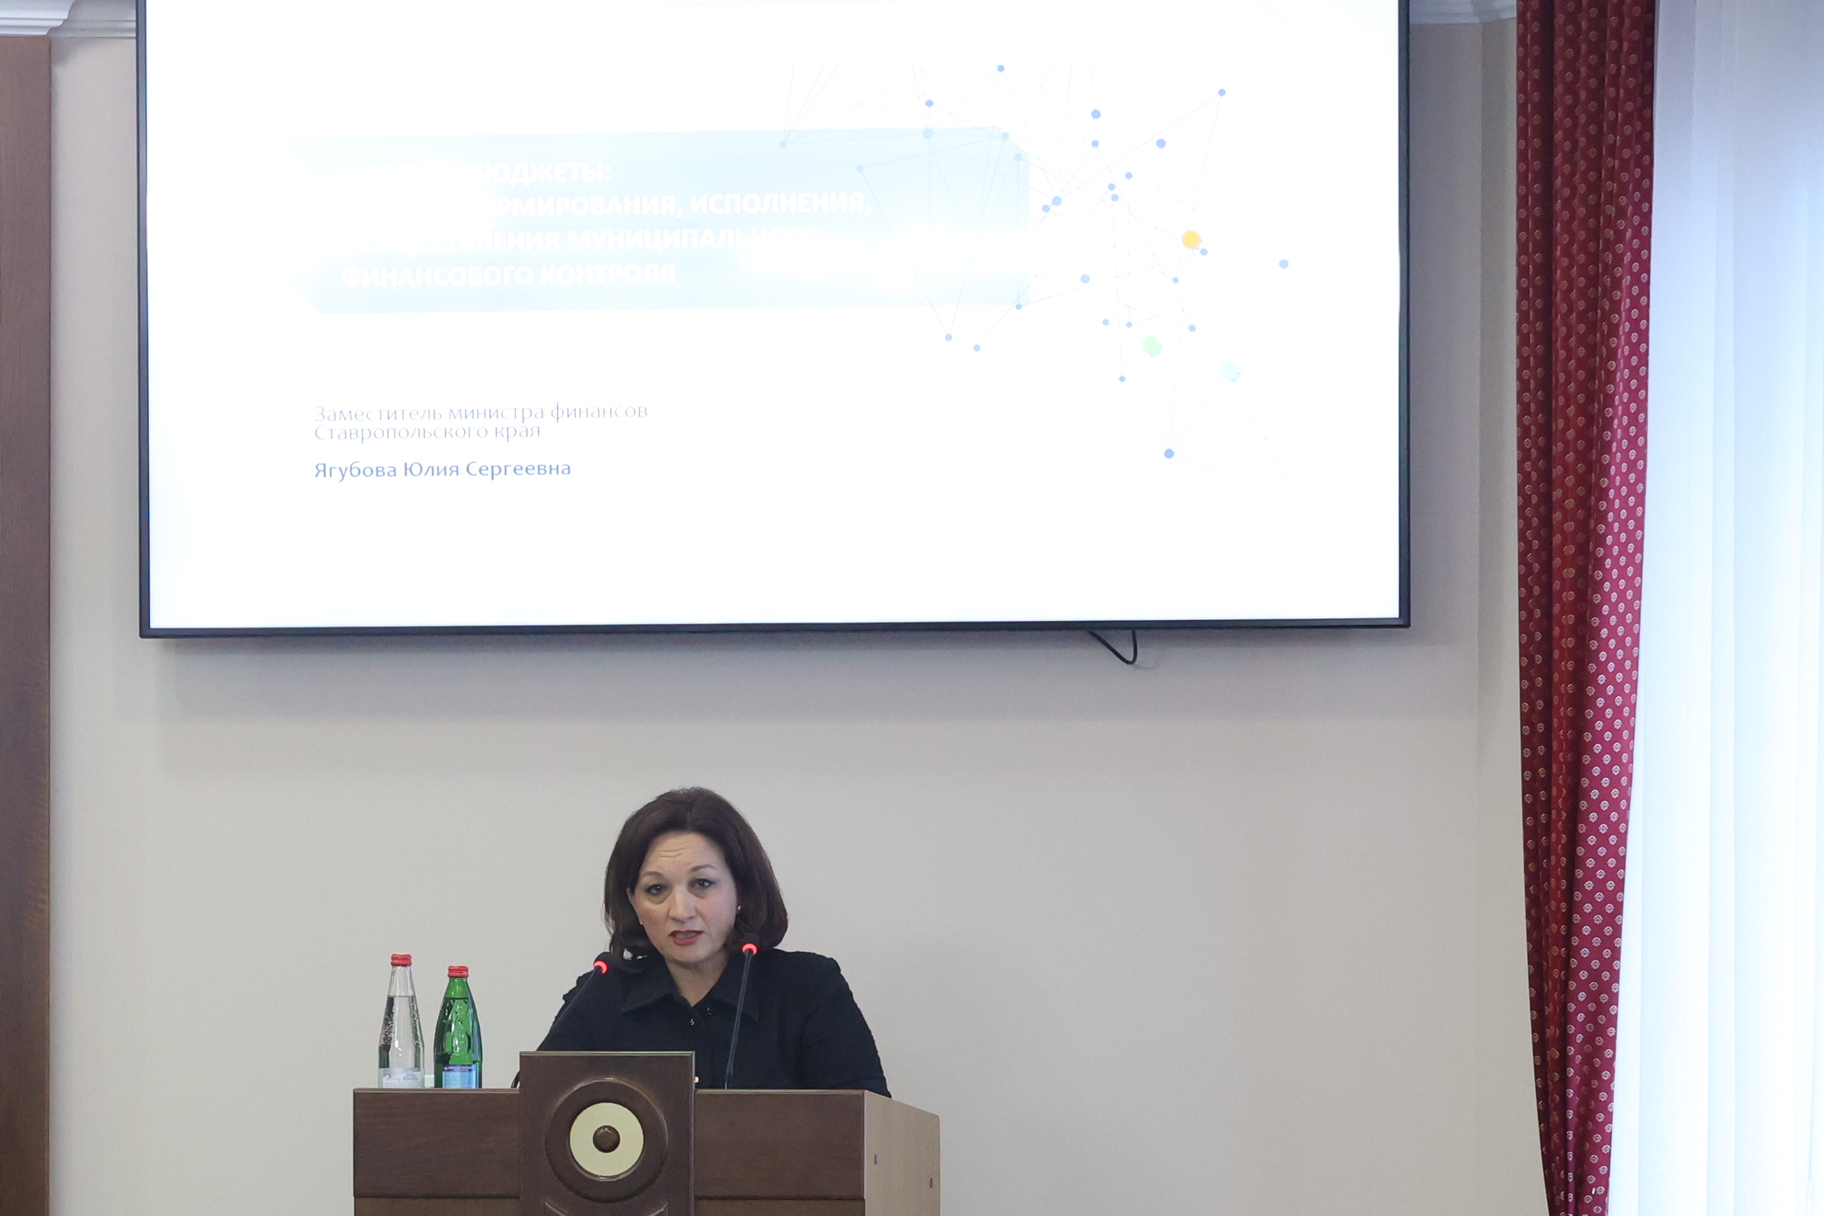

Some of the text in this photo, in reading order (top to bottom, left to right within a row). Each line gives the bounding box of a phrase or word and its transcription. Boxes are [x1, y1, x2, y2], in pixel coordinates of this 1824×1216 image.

[492, 191, 873, 219] РМИРОВАНИЯ, ИСПОЛНЕНИЯ,
[341, 262, 677, 288] ФИНАНСОВОГО КОНТРОЛЯ
[314, 402, 648, 423] Заместитель министра финансов
[314, 424, 541, 443] Ставропольского края
[314, 460, 571, 482] Ягубова Юлия Сергеевна
